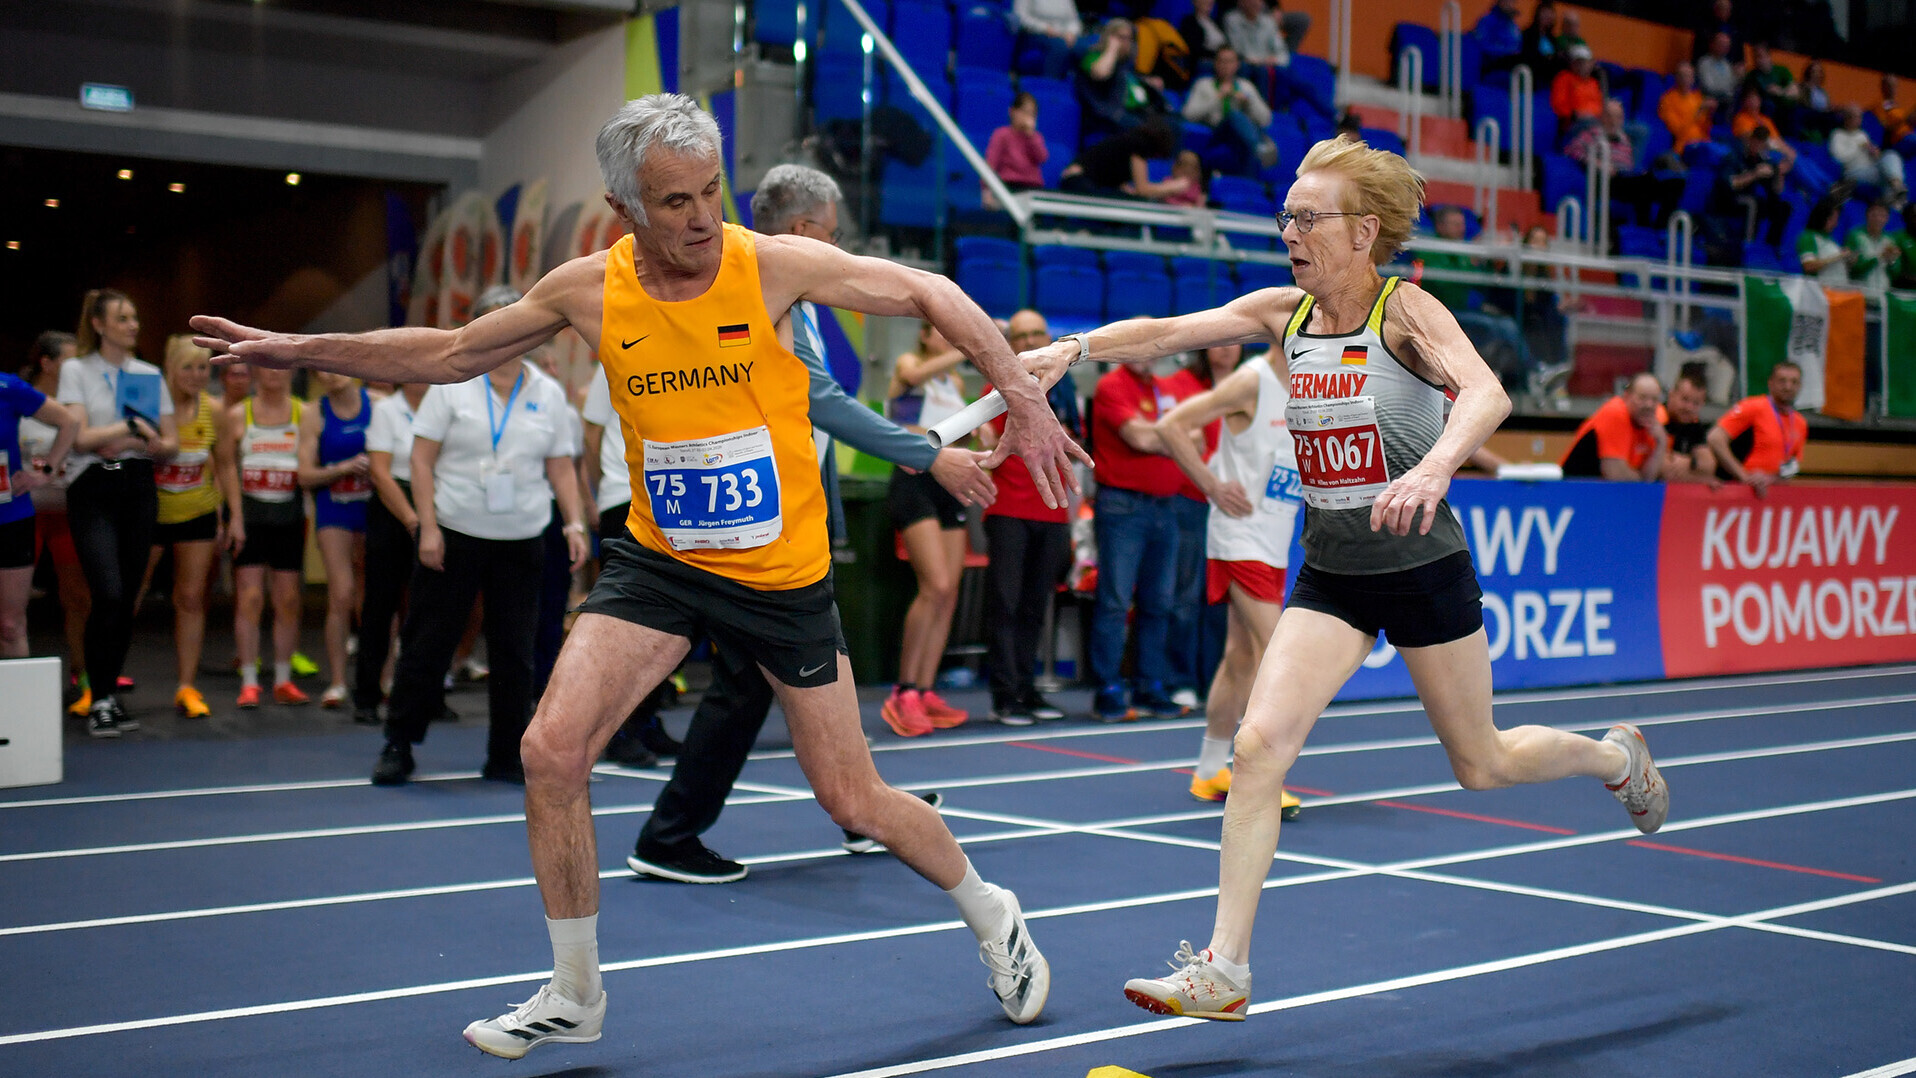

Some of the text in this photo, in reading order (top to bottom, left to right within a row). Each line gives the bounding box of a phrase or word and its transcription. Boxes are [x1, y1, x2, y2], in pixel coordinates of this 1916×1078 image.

[627, 361, 754, 396] GERMANY
[1289, 373, 1369, 399] GERMANY
[708, 434, 743, 446] Championships
[1294, 431, 1376, 473] 75 1067
[1302, 458, 1311, 473] W
[649, 468, 763, 513] 75 733
[666, 499, 681, 515] M
[697, 519, 720, 528] Jürgen
[720, 515, 754, 526] Freymuth
[1702, 505, 1899, 571] KUJAWY
[1700, 574, 1916, 648] POMORZE
